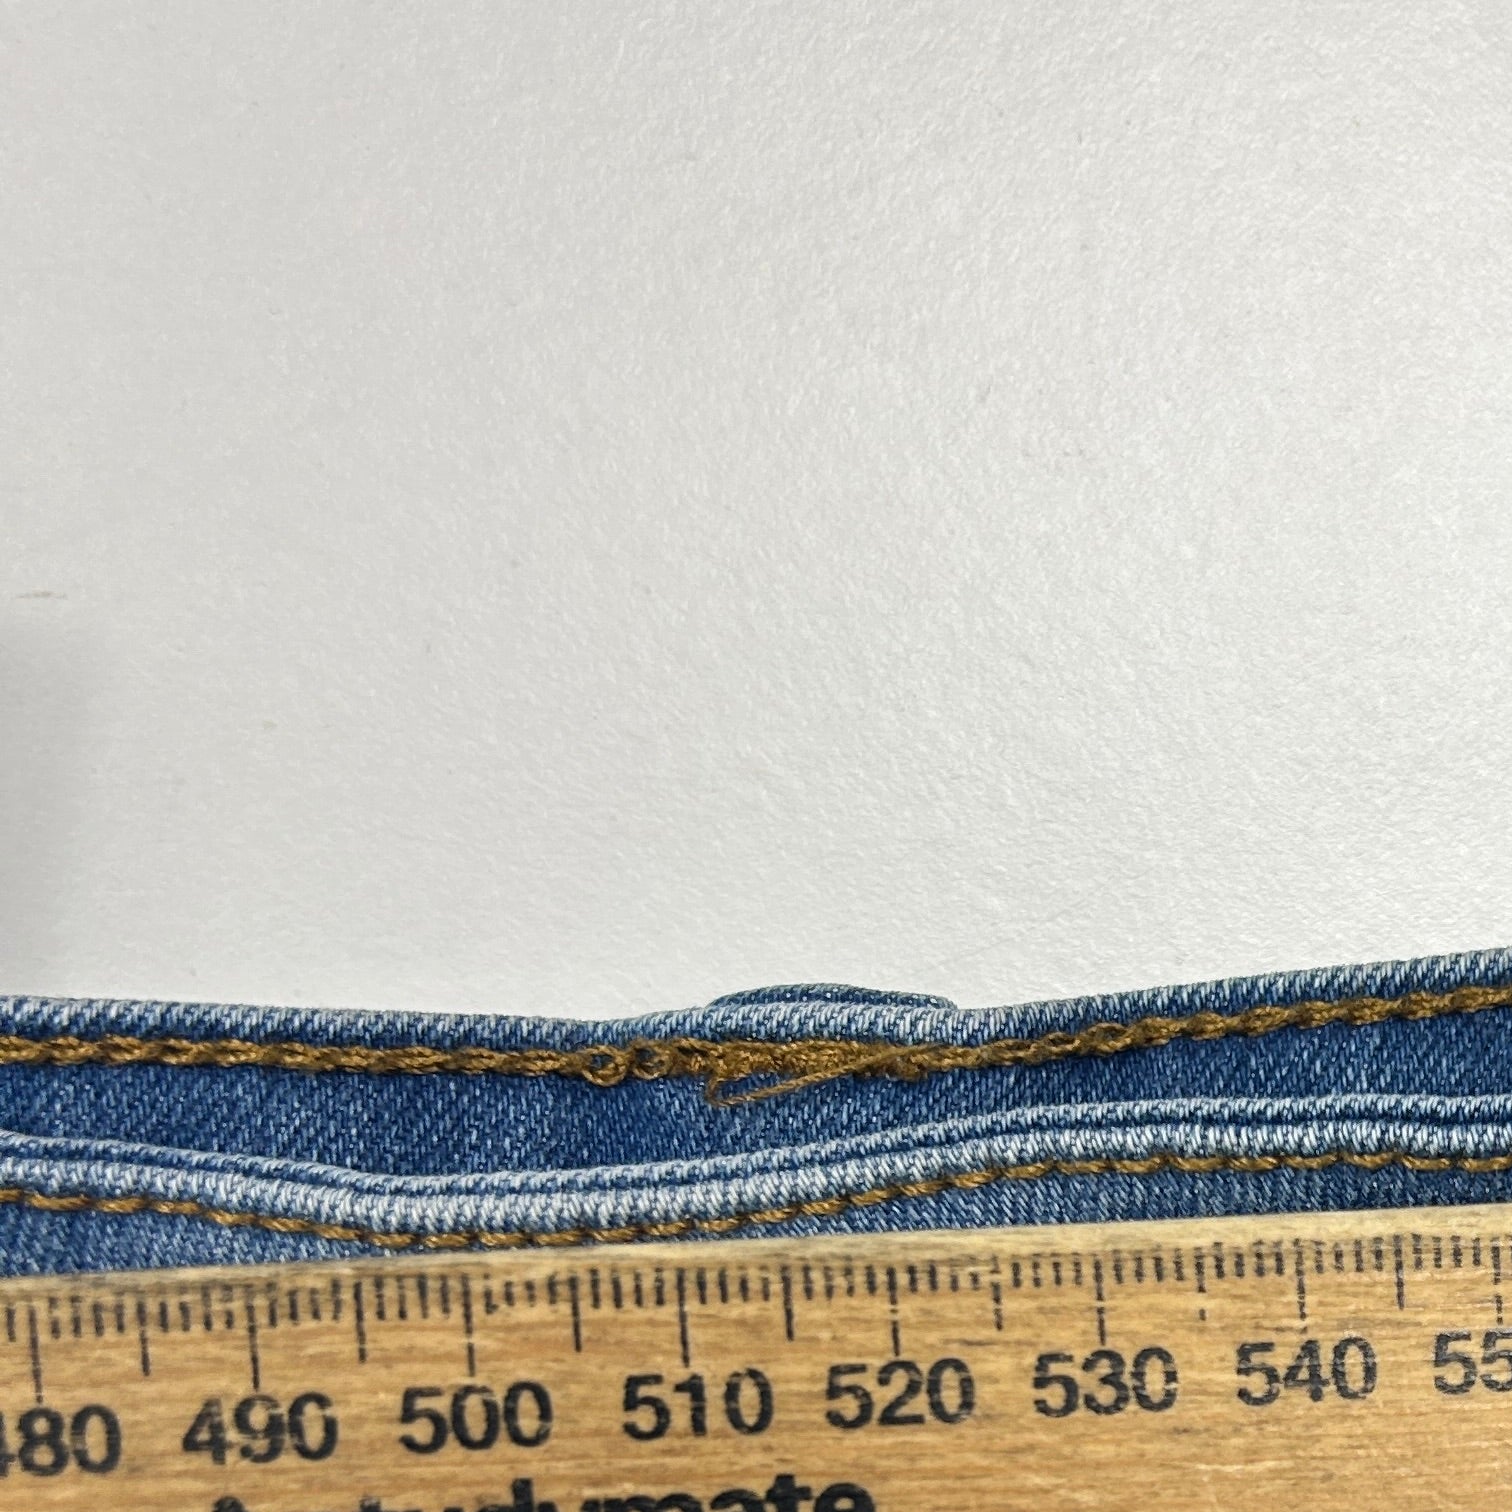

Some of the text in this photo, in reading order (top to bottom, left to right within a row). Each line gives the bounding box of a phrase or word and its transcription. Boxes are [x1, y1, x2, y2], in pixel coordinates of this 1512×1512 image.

[0, 1405, 121, 1477] 80
[182, 1391, 338, 1466] 490
[397, 1380, 553, 1455] 500
[622, 1368, 774, 1442] 510
[825, 1358, 976, 1432] 520
[1033, 1347, 1178, 1419] 530
[1236, 1336, 1377, 1406] 540
